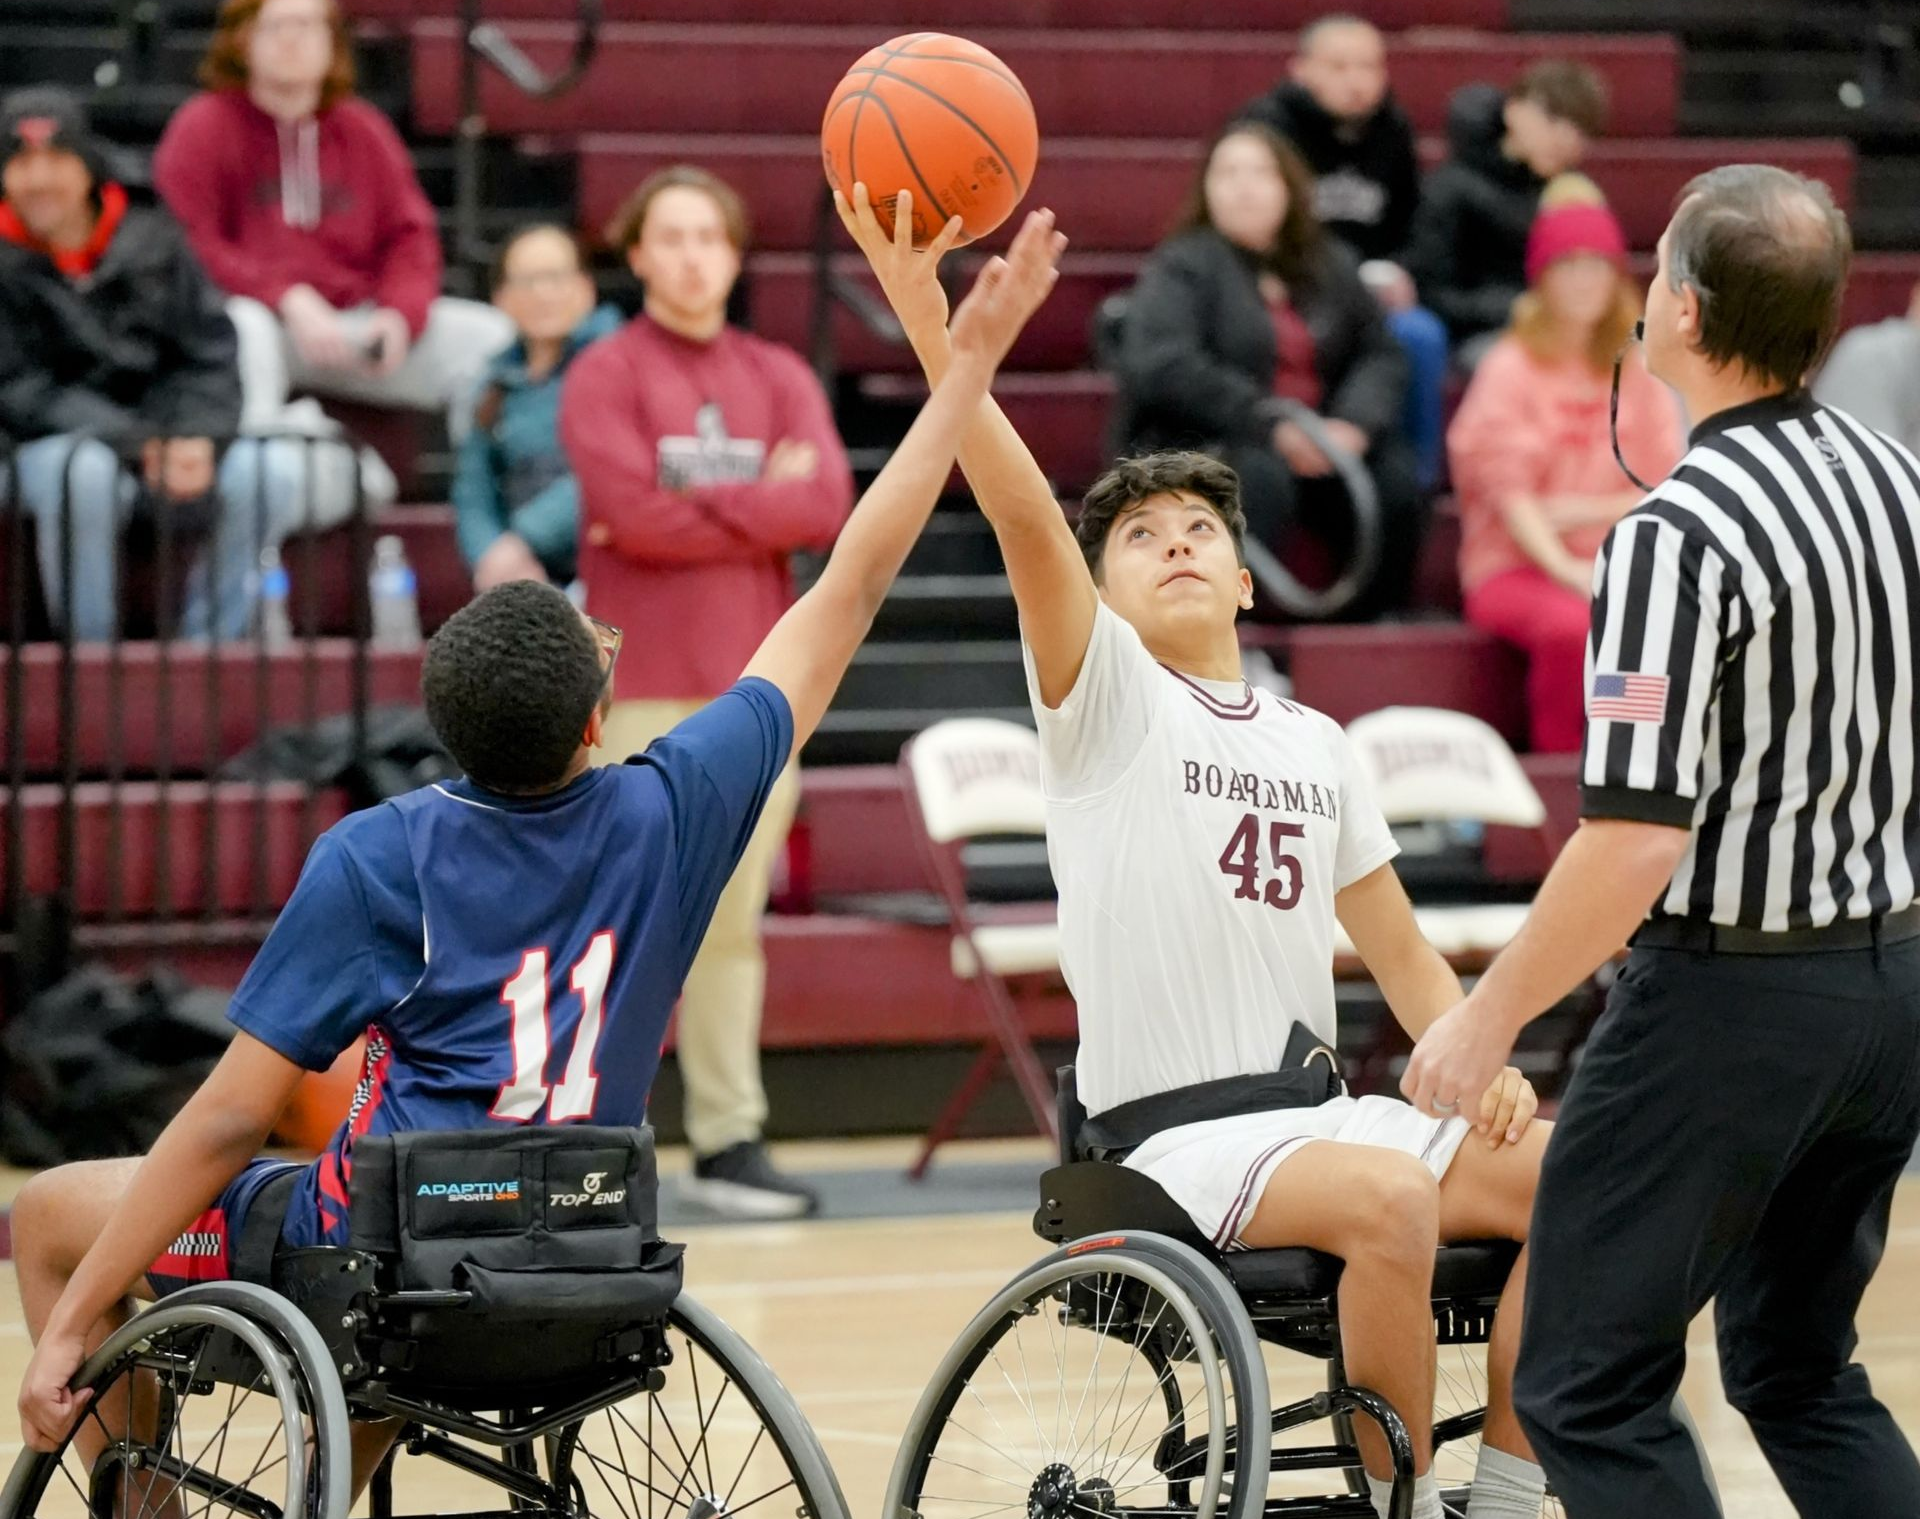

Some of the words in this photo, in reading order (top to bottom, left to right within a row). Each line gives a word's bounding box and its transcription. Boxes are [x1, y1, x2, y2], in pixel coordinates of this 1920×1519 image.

[1182, 759, 1337, 822] BOARDMAN
[1218, 813, 1306, 911] 45
[487, 929, 617, 1125] 11
[416, 1180, 519, 1197] ADAPTIVE
[447, 1192, 494, 1203] SPORTS
[495, 1192, 520, 1201] OHIO
[549, 1193, 590, 1208] TOP
[591, 1190, 625, 1206] END
